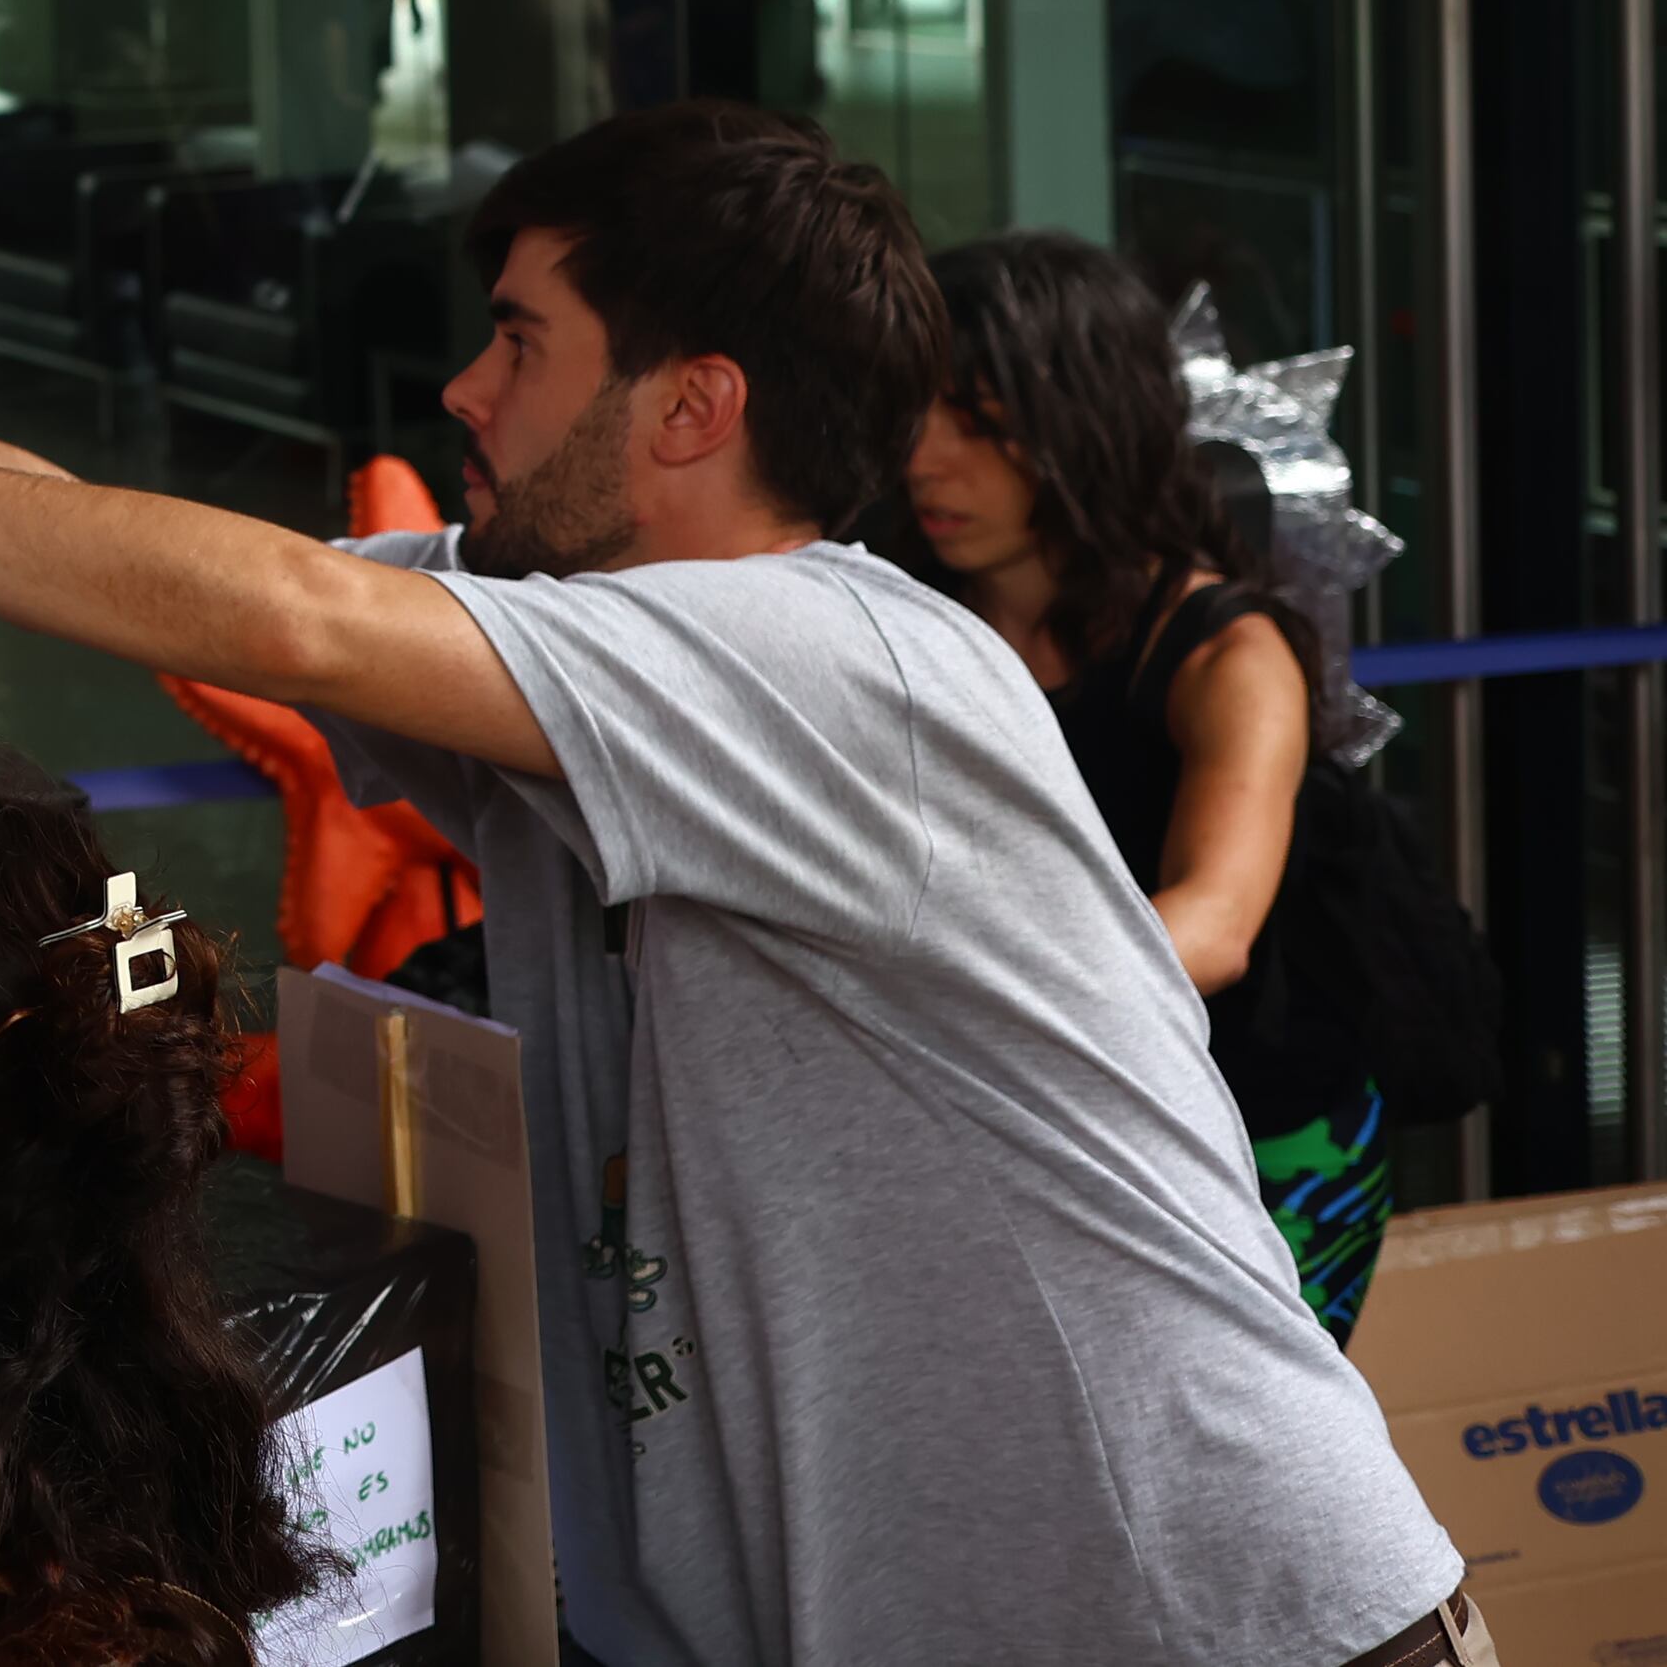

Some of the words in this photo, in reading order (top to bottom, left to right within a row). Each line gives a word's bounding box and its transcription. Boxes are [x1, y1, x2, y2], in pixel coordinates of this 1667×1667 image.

[343, 1422, 376, 1455] NO
[1462, 1388, 1667, 1461] estrella
[358, 1470, 389, 1502] ES
